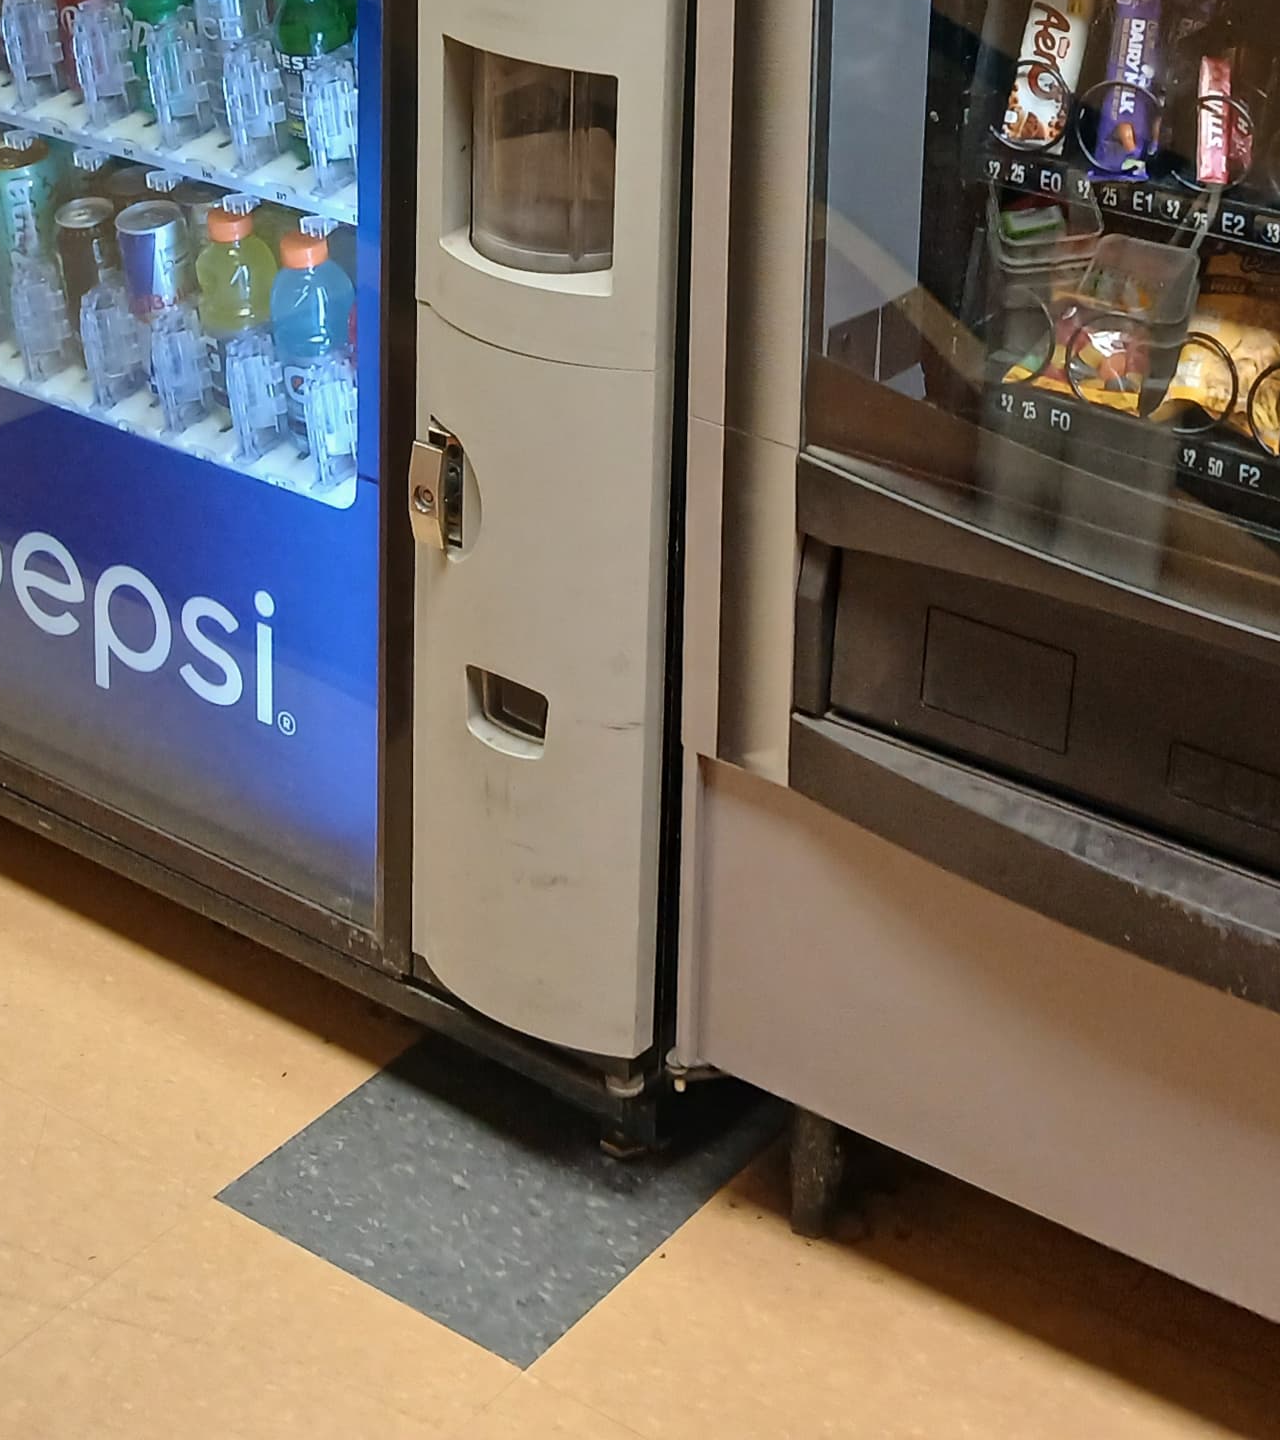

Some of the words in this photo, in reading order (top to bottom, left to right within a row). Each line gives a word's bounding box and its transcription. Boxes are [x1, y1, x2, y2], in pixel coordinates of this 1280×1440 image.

[1040, 170, 1061, 192] E0
[1133, 191, 1153, 212] E1
[1222, 212, 1245, 236] E2
[1051, 409, 1071, 431] F0
[1239, 464, 1261, 488] F2
